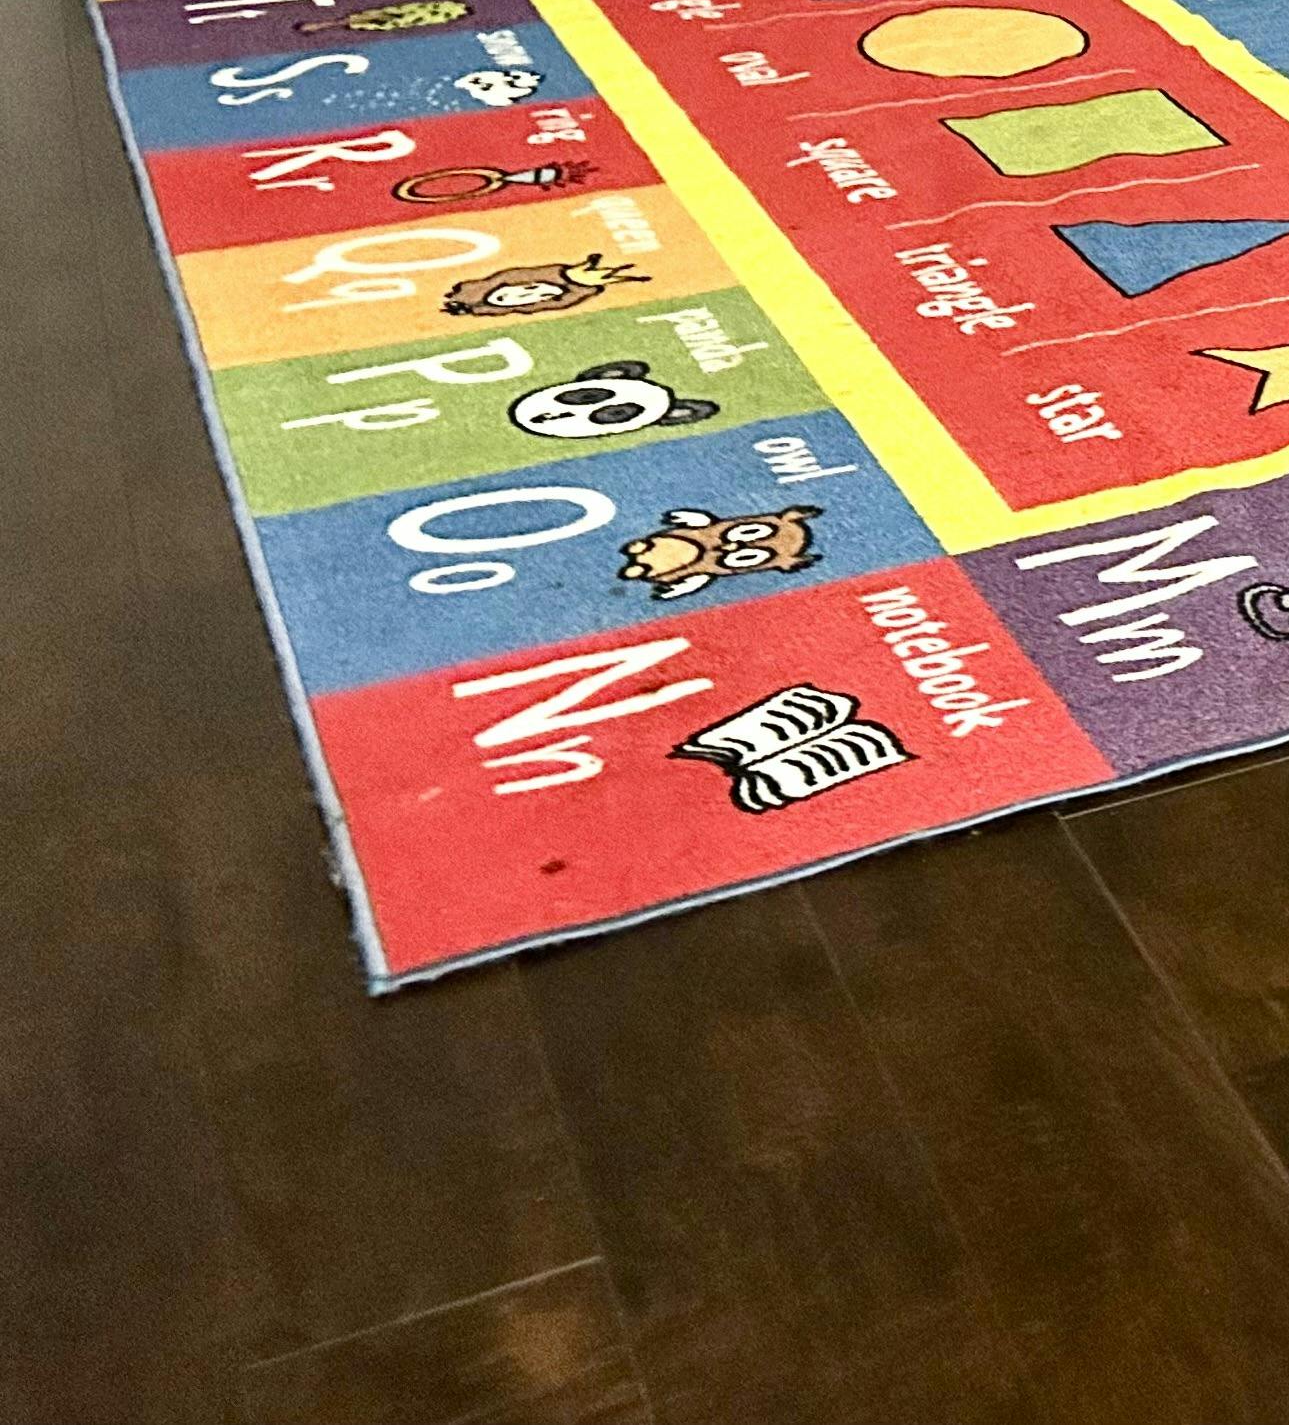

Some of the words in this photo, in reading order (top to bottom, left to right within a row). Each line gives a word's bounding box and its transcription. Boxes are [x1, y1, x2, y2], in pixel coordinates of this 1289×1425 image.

[210, 53, 370, 106] Ss
[719, 50, 811, 87] oval
[527, 107, 592, 146] ring
[241, 128, 417, 193] Rr
[786, 137, 898, 204] square
[571, 194, 662, 254] queen
[281, 227, 502, 314] Qq
[894, 242, 1035, 336] triangle
[636, 306, 770, 374] panda
[280, 337, 535, 431] Pp
[1026, 384, 1123, 443] star
[752, 435, 858, 485] owl
[387, 486, 618, 595] Oo
[1014, 515, 1258, 683] Mm
[860, 584, 1031, 739] notebook
[452, 636, 714, 795] Nn
